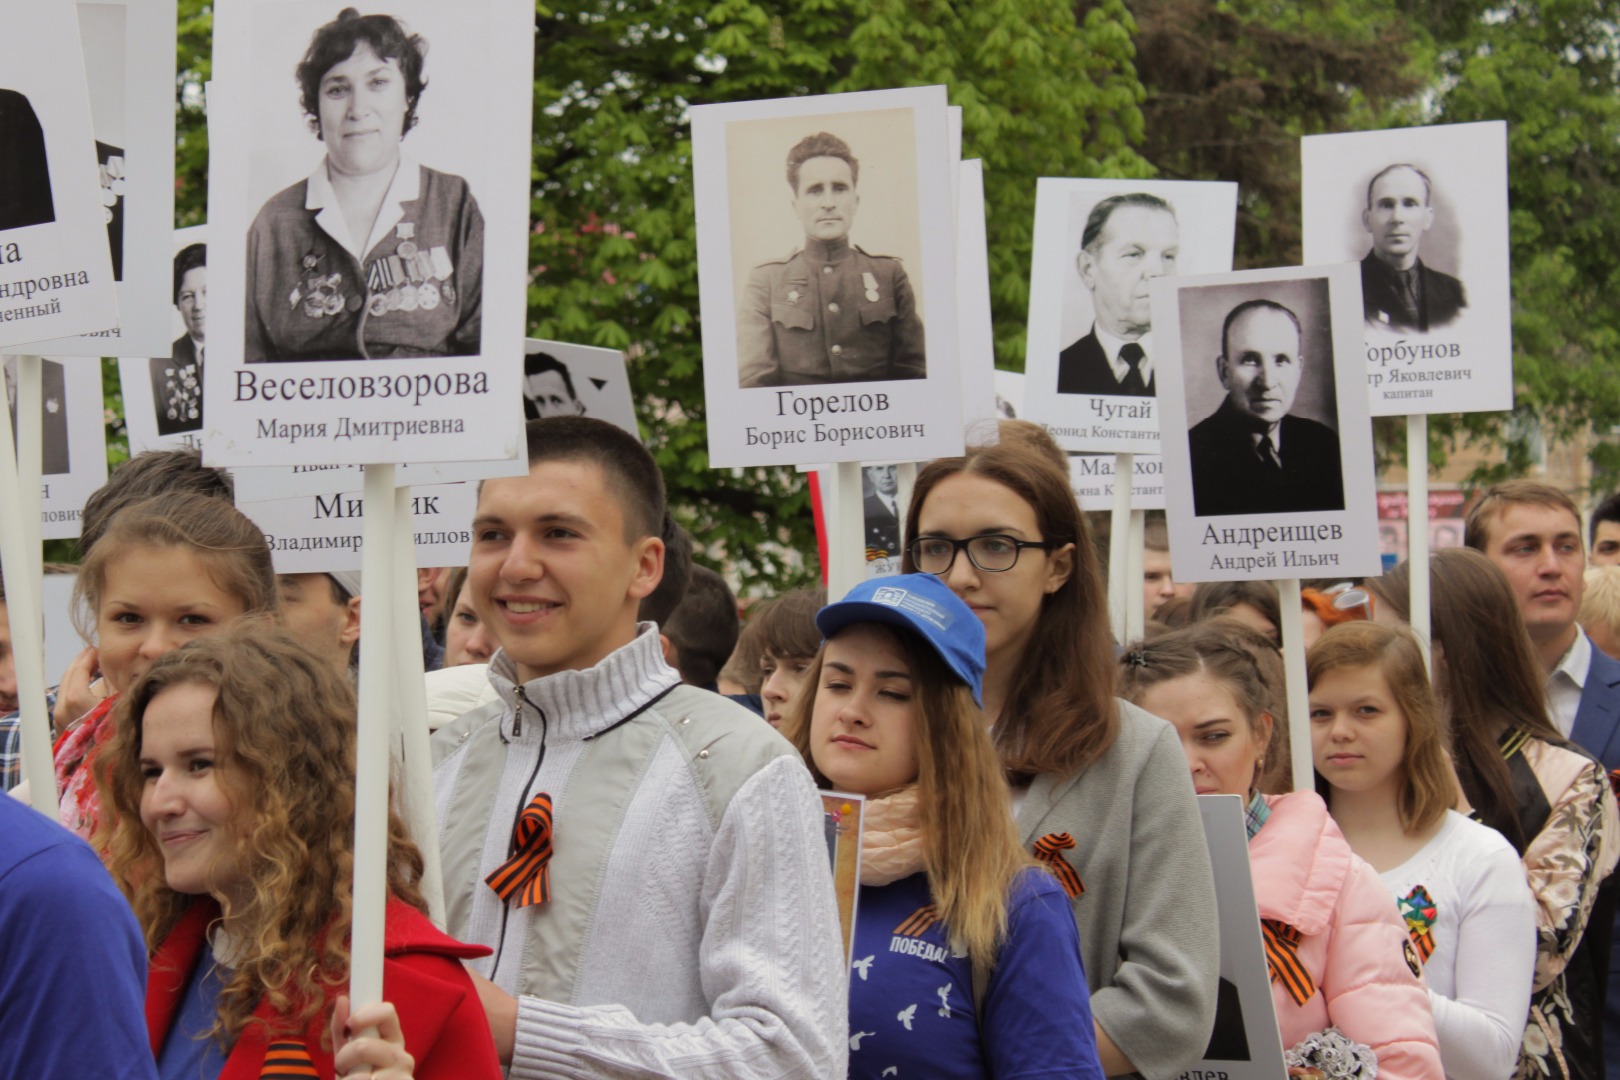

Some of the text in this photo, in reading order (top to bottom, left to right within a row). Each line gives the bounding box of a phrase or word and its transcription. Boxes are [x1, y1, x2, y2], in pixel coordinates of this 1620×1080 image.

[1365, 340, 1461, 366] орбунов
[234, 370, 489, 406] Веселовзорова
[1389, 369, 1471, 383] Яковлевич
[776, 391, 890, 420] Горелов
[1383, 389, 1433, 400] капитан
[1089, 399, 1152, 421] Чугай
[256, 417, 464, 443] Мария Дмитриевна
[745, 423, 925, 449] Борис Борисович
[265, 534, 363, 552] Владимир
[1202, 523, 1343, 549] Андреищев
[1210, 551, 1340, 572] Андрей Ильич
[889, 936, 949, 964] ПОБЕДА!
